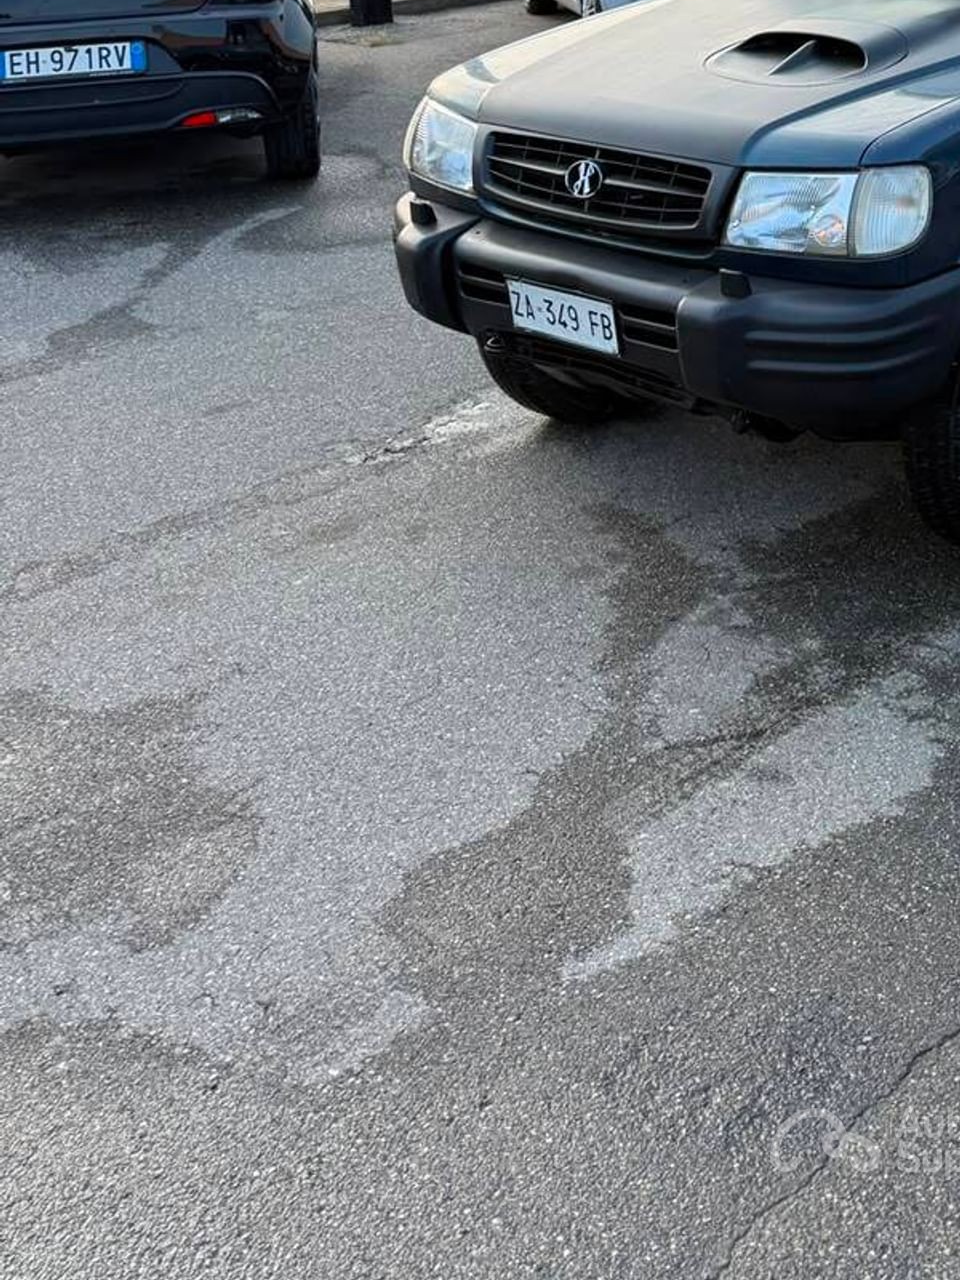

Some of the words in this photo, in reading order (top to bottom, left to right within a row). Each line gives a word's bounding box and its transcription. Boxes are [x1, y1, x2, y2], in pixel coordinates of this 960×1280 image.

[9, 50, 40, 76] EH
[50, 44, 127, 73] 971RV
[542, 298, 580, 332] 349
[588, 310, 614, 341] FB
